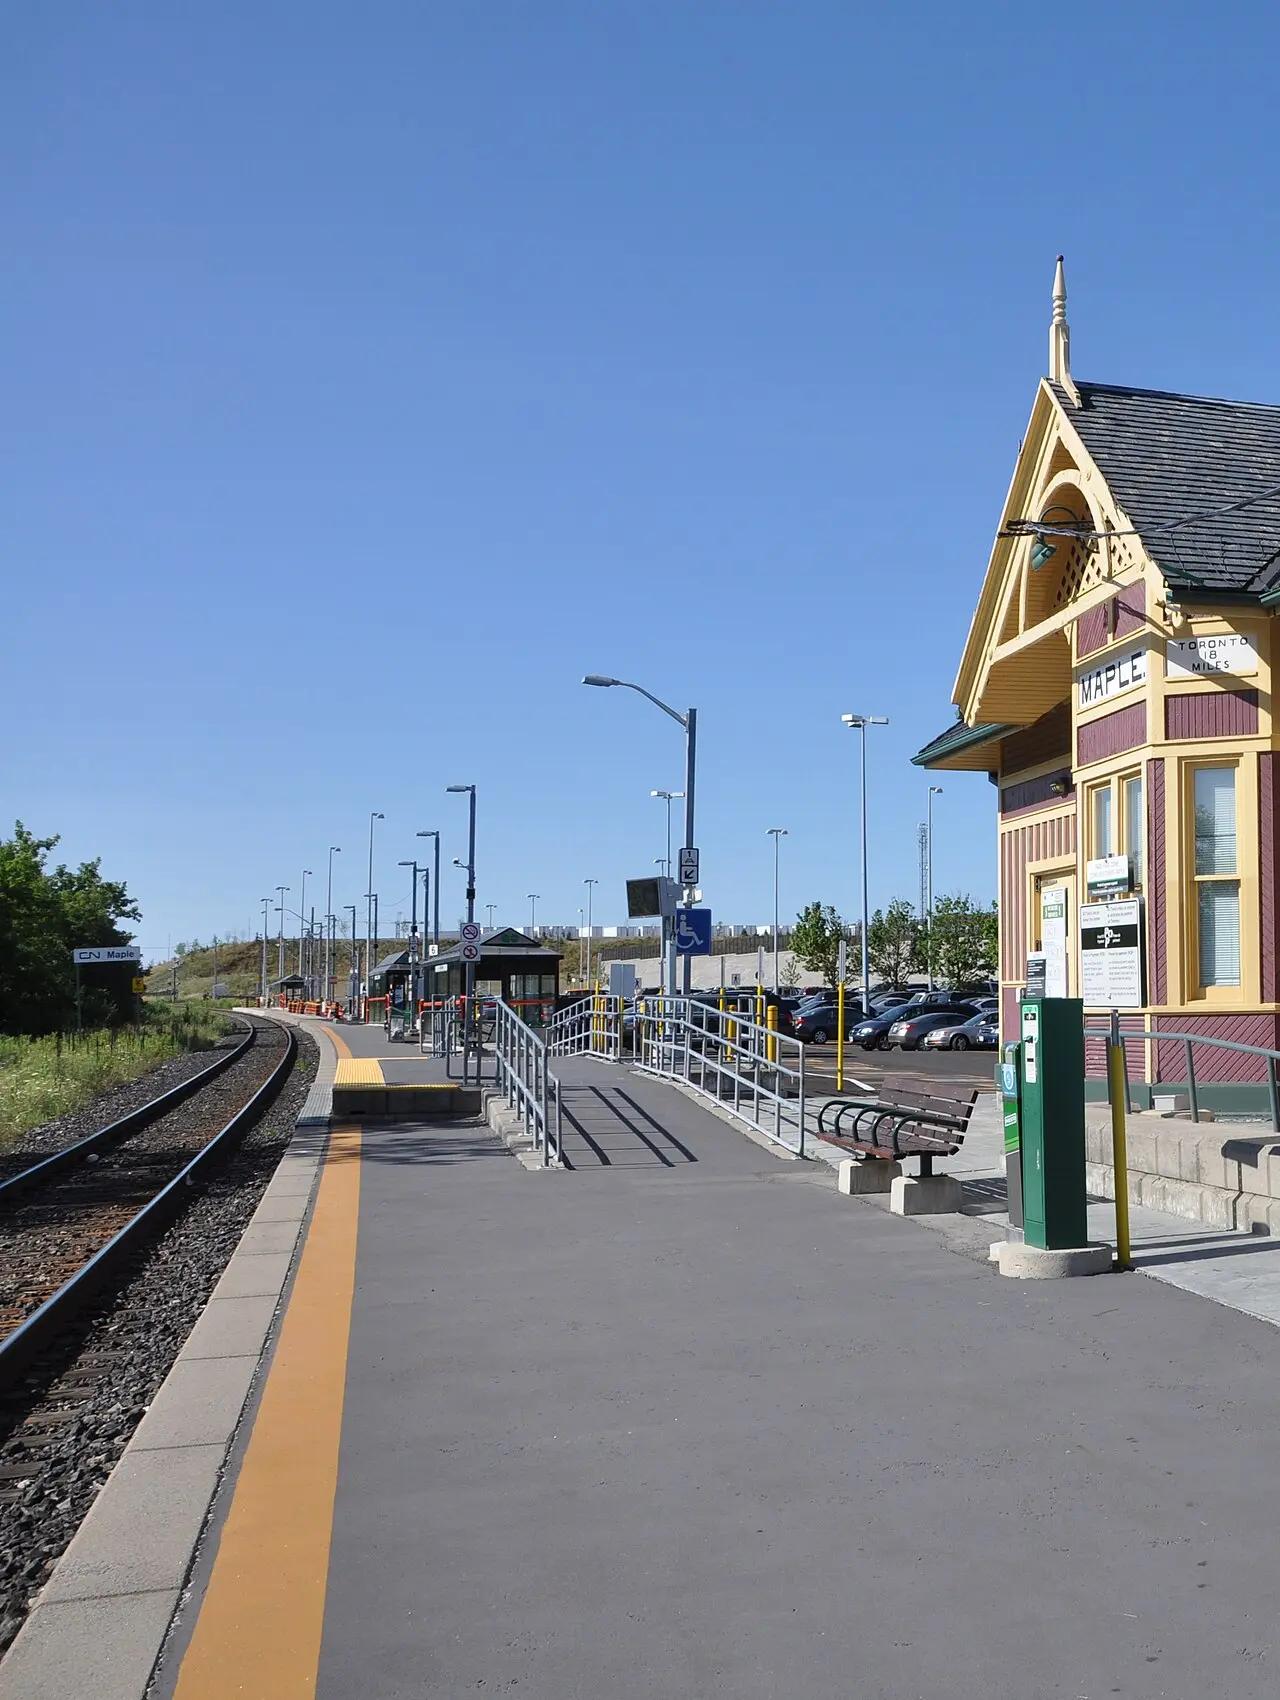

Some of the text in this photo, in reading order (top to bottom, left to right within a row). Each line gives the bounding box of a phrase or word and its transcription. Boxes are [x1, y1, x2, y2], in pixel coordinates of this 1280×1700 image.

[1178, 637, 1249, 651] TORONTO
[1204, 650, 1217, 660] 18
[1191, 660, 1230, 672] MILES
[1081, 651, 1146, 705] MAPLE.
[79, 951, 134, 960] CN Maple
